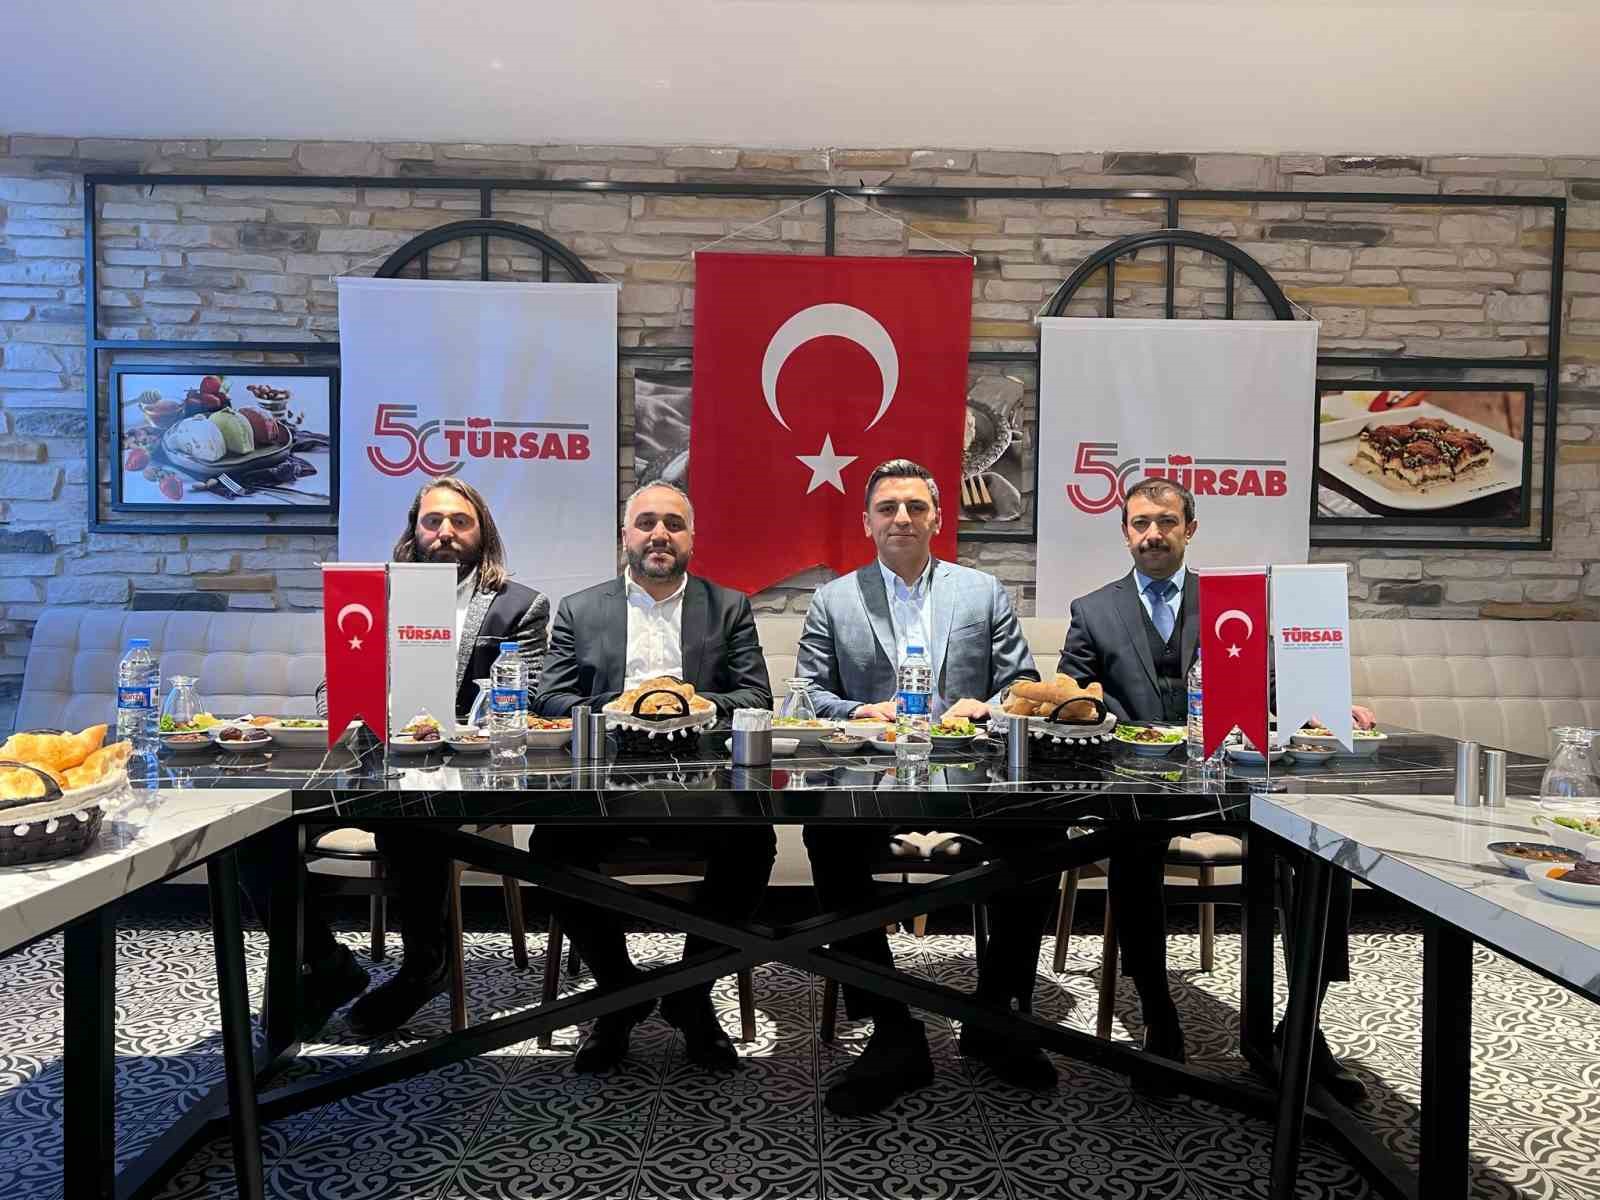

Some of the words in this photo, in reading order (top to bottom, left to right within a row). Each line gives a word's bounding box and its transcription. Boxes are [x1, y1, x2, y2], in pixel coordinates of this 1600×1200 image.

[444, 429, 590, 460] TÜRSAB
[397, 627, 451, 640] TÜRSAB
[1282, 629, 1343, 642] TÜRSAB
